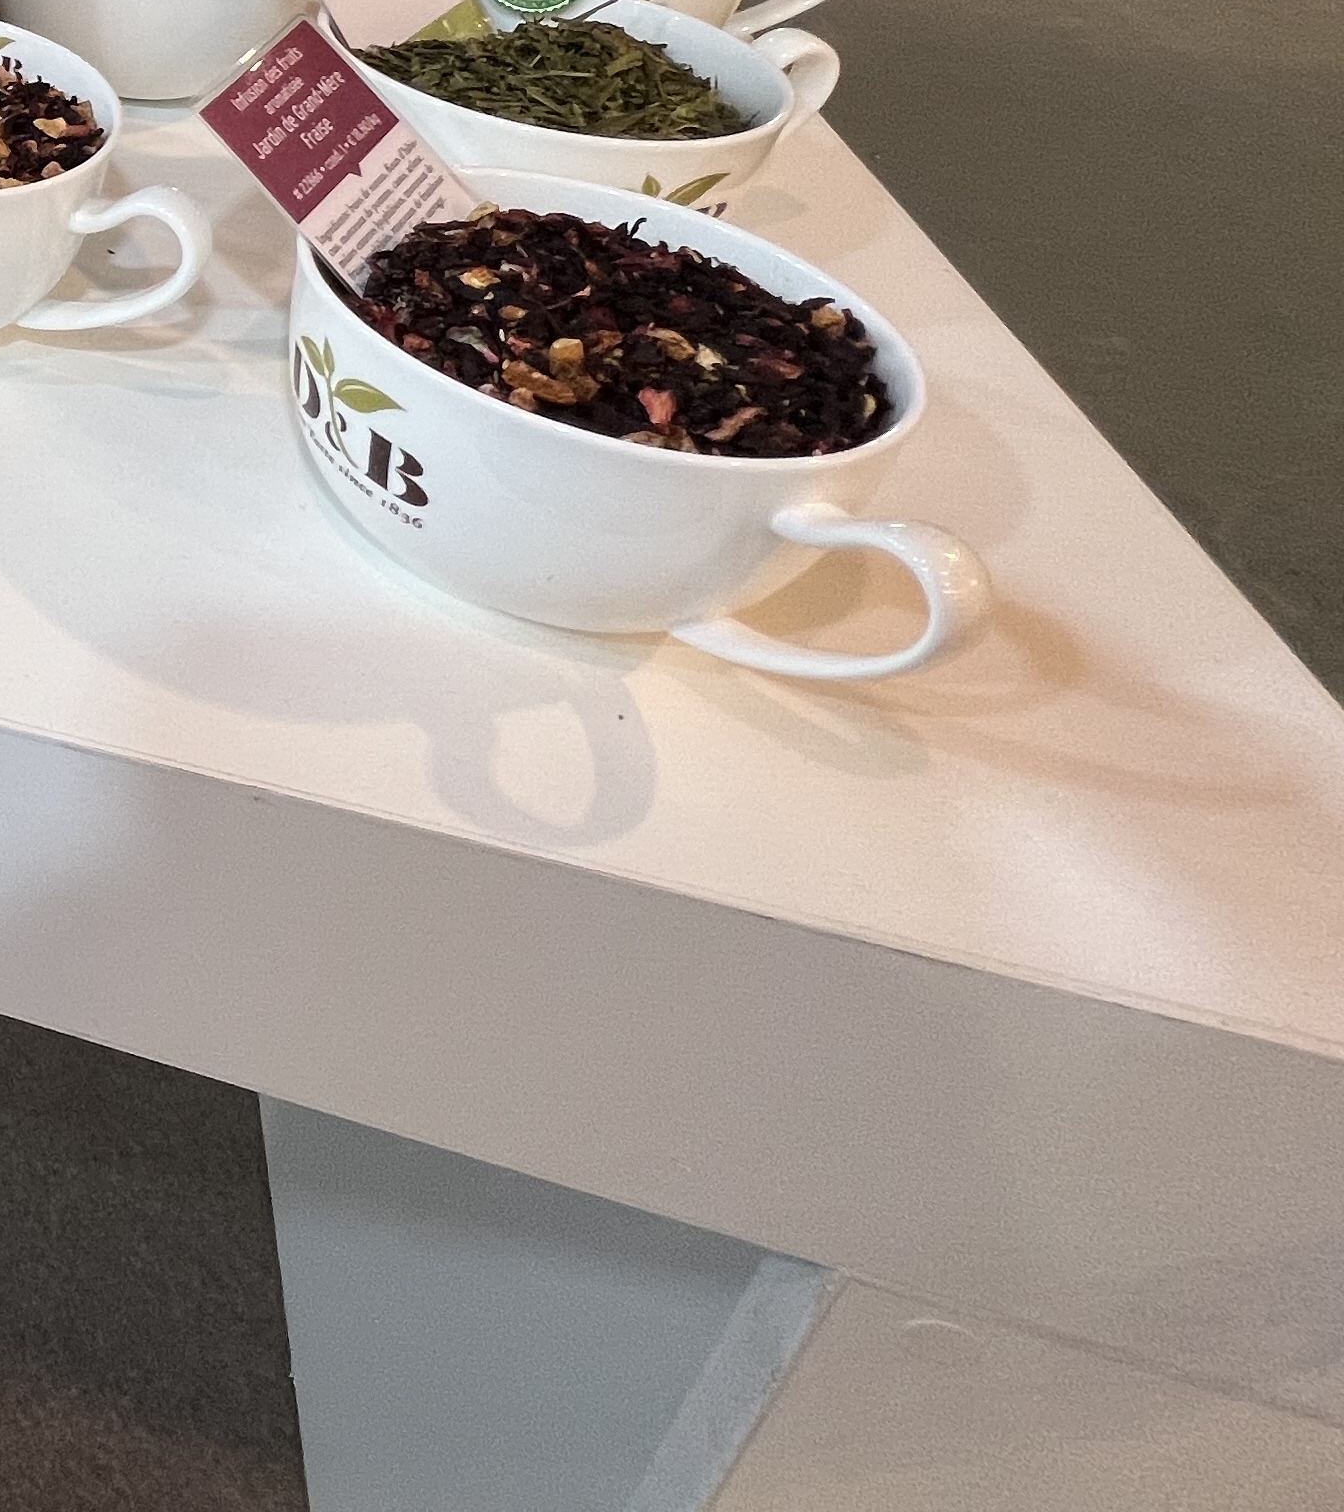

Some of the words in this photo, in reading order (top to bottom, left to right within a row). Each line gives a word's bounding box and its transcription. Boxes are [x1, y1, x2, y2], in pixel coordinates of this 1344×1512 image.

[253, 126, 287, 160] Jardin
[281, 116, 299, 133] de
[291, 71, 345, 121] Grand-Mère
[300, 117, 333, 149] Fraise
[293, 340, 430, 507] D&B
